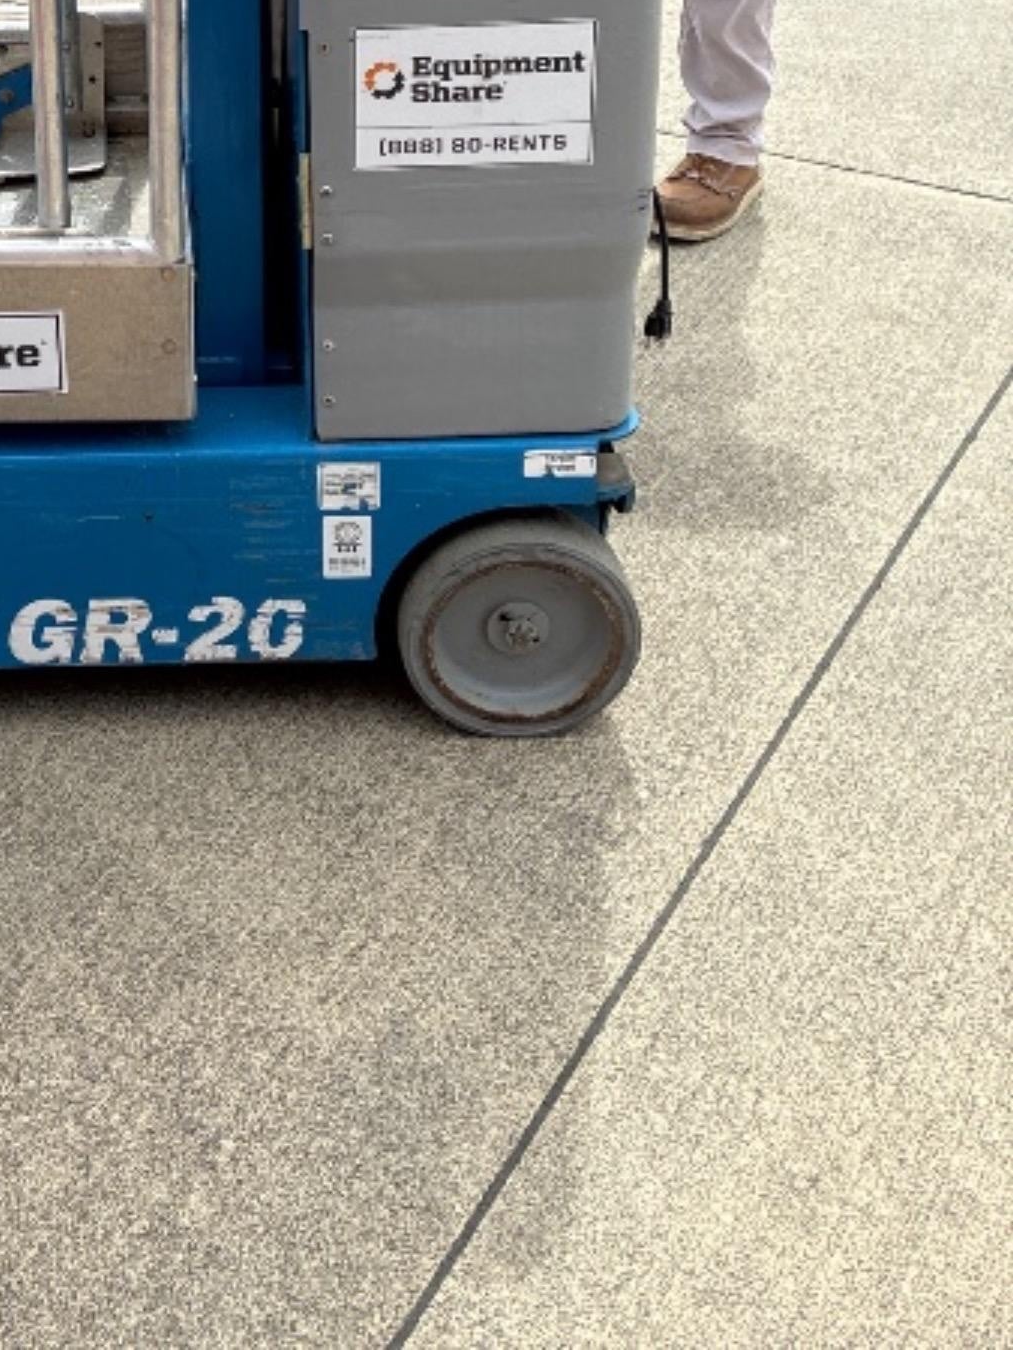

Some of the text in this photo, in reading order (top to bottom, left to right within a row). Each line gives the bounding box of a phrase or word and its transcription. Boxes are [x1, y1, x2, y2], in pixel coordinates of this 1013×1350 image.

[411, 51, 586, 82] Equipment
[411, 80, 504, 103] Share
[451, 134, 568, 156] 80-RENTS
[8, 596, 309, 666] GR-20
